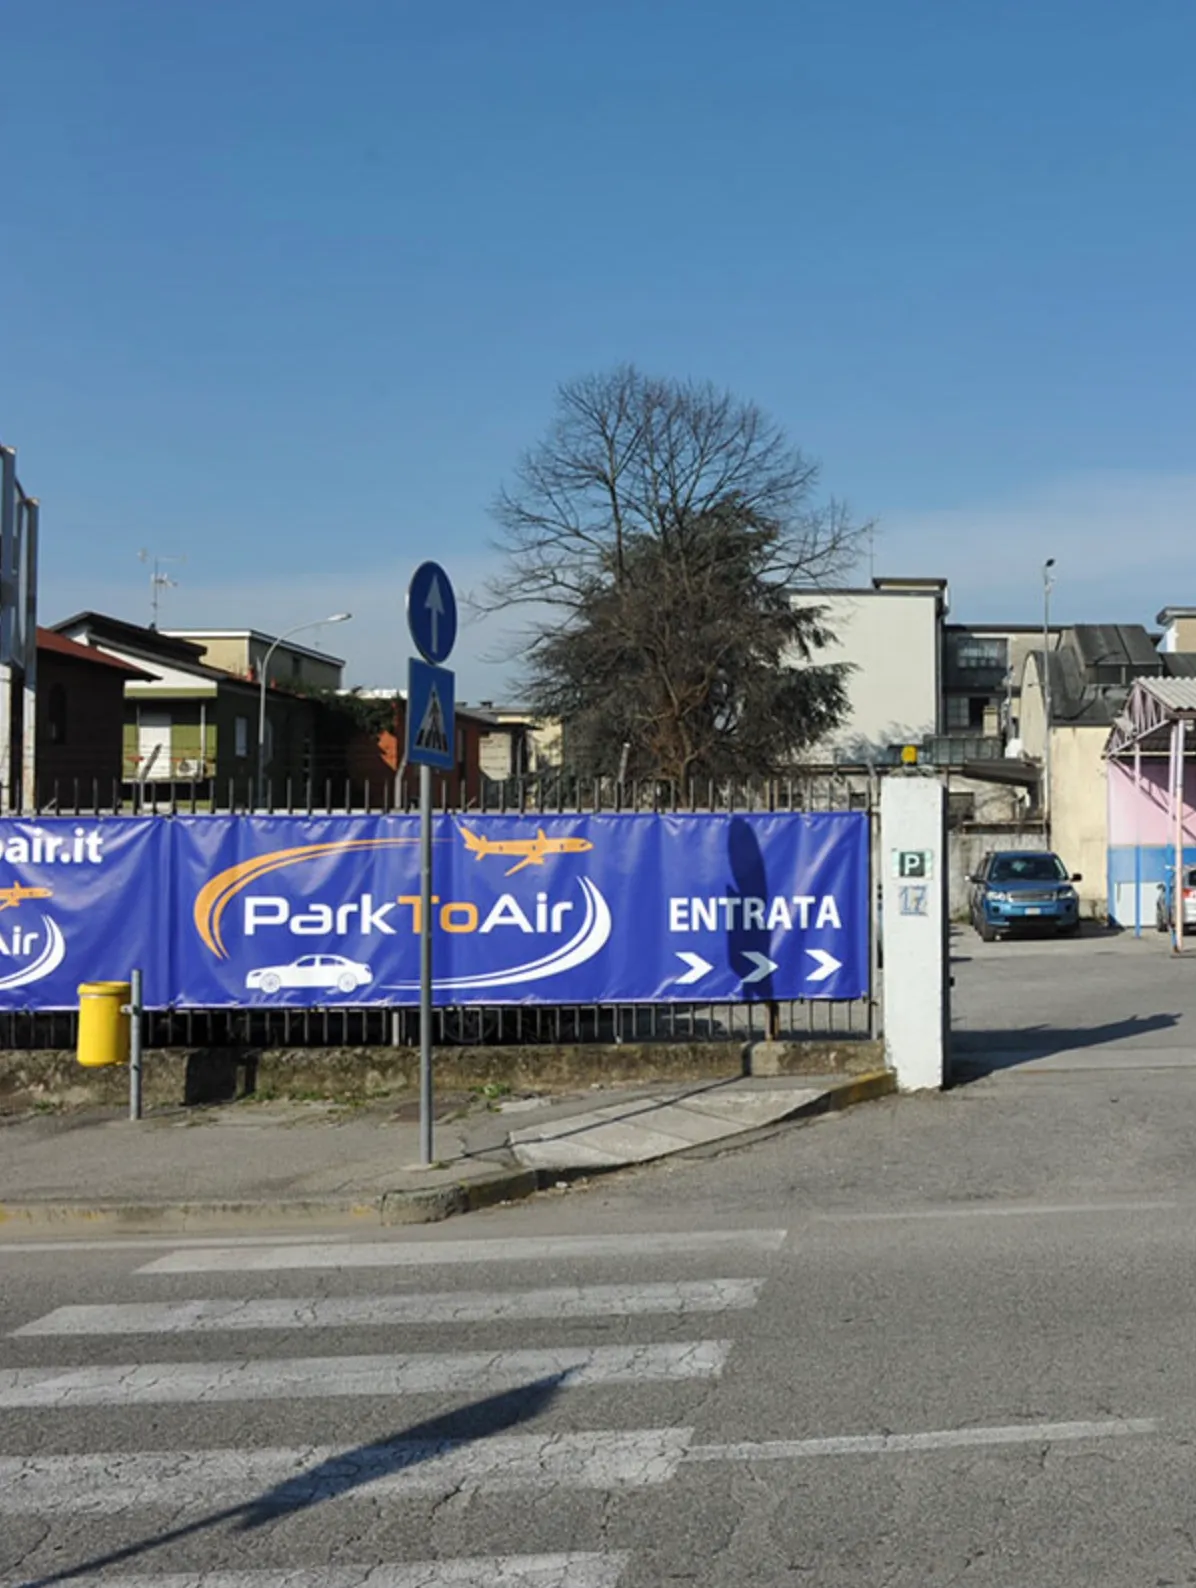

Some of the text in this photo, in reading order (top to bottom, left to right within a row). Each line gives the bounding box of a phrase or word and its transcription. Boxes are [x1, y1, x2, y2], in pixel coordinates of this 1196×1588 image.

[0, 827, 103, 864] air.it
[905, 854, 920, 875] P
[244, 892, 573, 935] ParkToAir
[669, 895, 842, 932] ENTRATA
